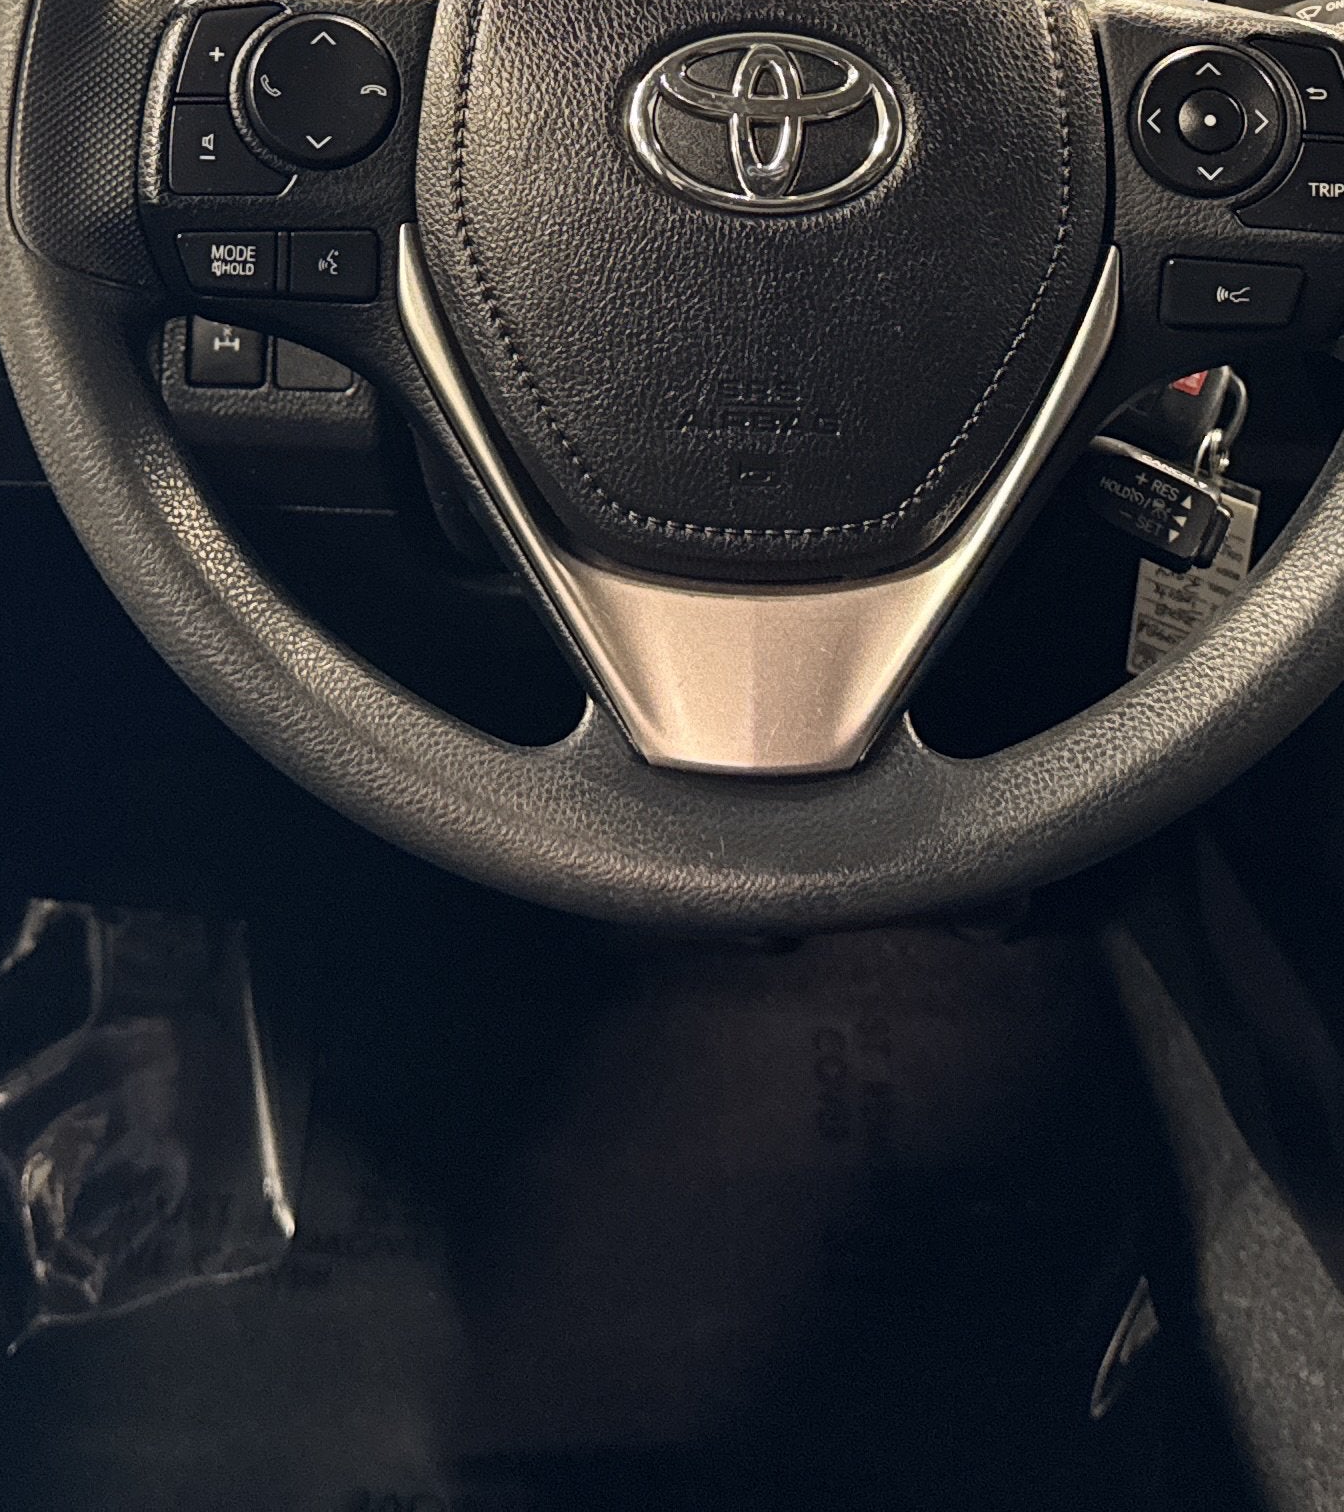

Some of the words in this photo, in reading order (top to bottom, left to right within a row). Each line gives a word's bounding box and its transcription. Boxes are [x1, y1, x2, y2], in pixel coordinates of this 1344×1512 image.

[1325, 0, 1344, 11] ON
[211, 244, 256, 261] MODE
[222, 262, 255, 276] HOLD
[1150, 479, 1180, 502] RES
